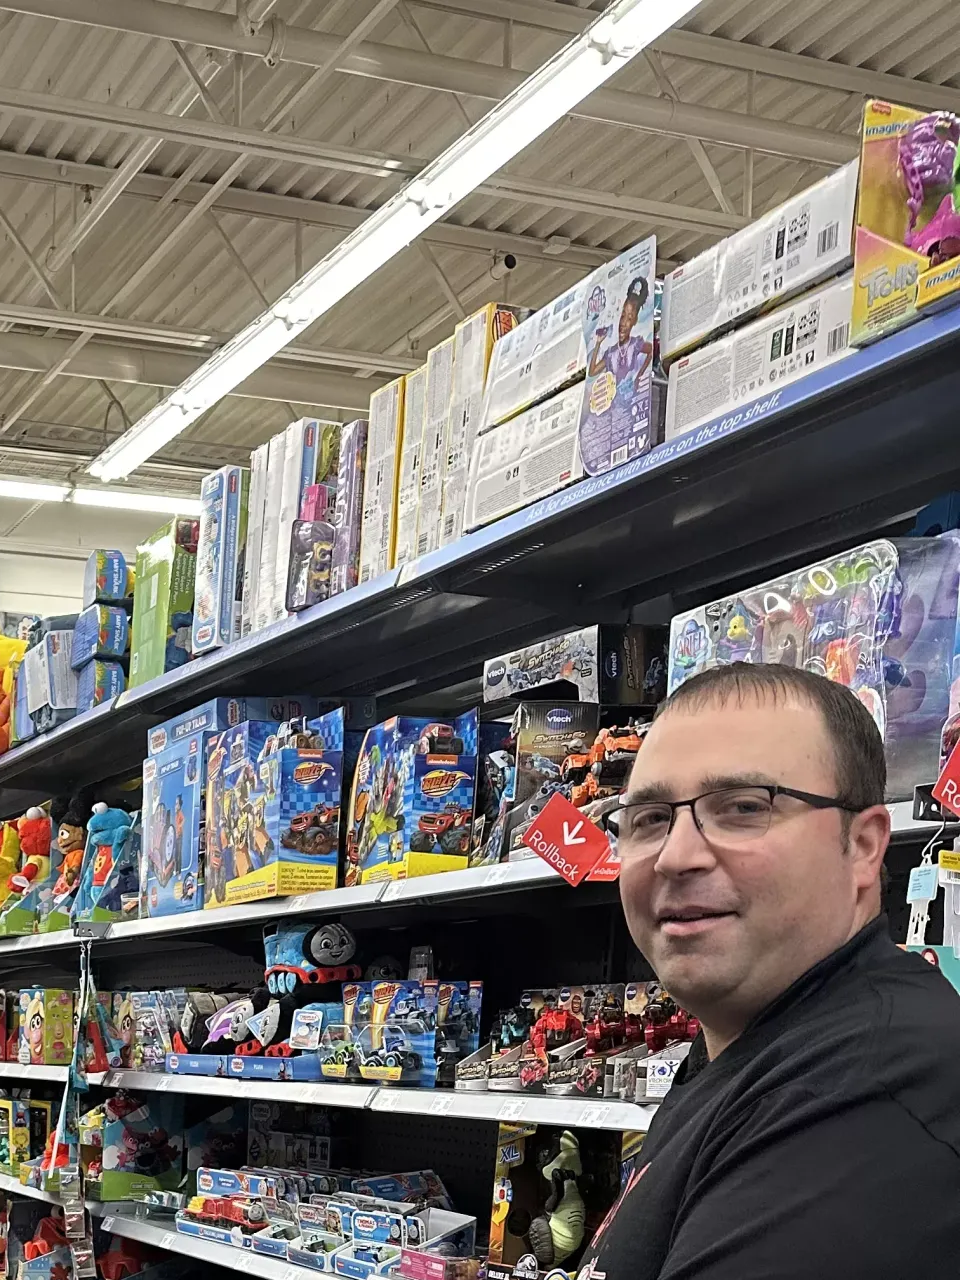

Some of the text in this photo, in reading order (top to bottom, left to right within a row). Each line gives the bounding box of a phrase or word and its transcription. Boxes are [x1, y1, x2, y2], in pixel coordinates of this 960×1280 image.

[925, 262, 960, 288] imagi
[524, 391, 781, 524] Ask for assistance with items on the top shelf.
[112, 573, 121, 594] SHARK
[114, 630, 123, 650] SHARK
[678, 634, 702, 658] ARIEL
[487, 666, 505, 679] vtech
[546, 715, 572, 724] vtech
[422, 773, 457, 790] BLAZE
[528, 829, 579, 881] Rollback
[500, 1143, 521, 1164] XL
